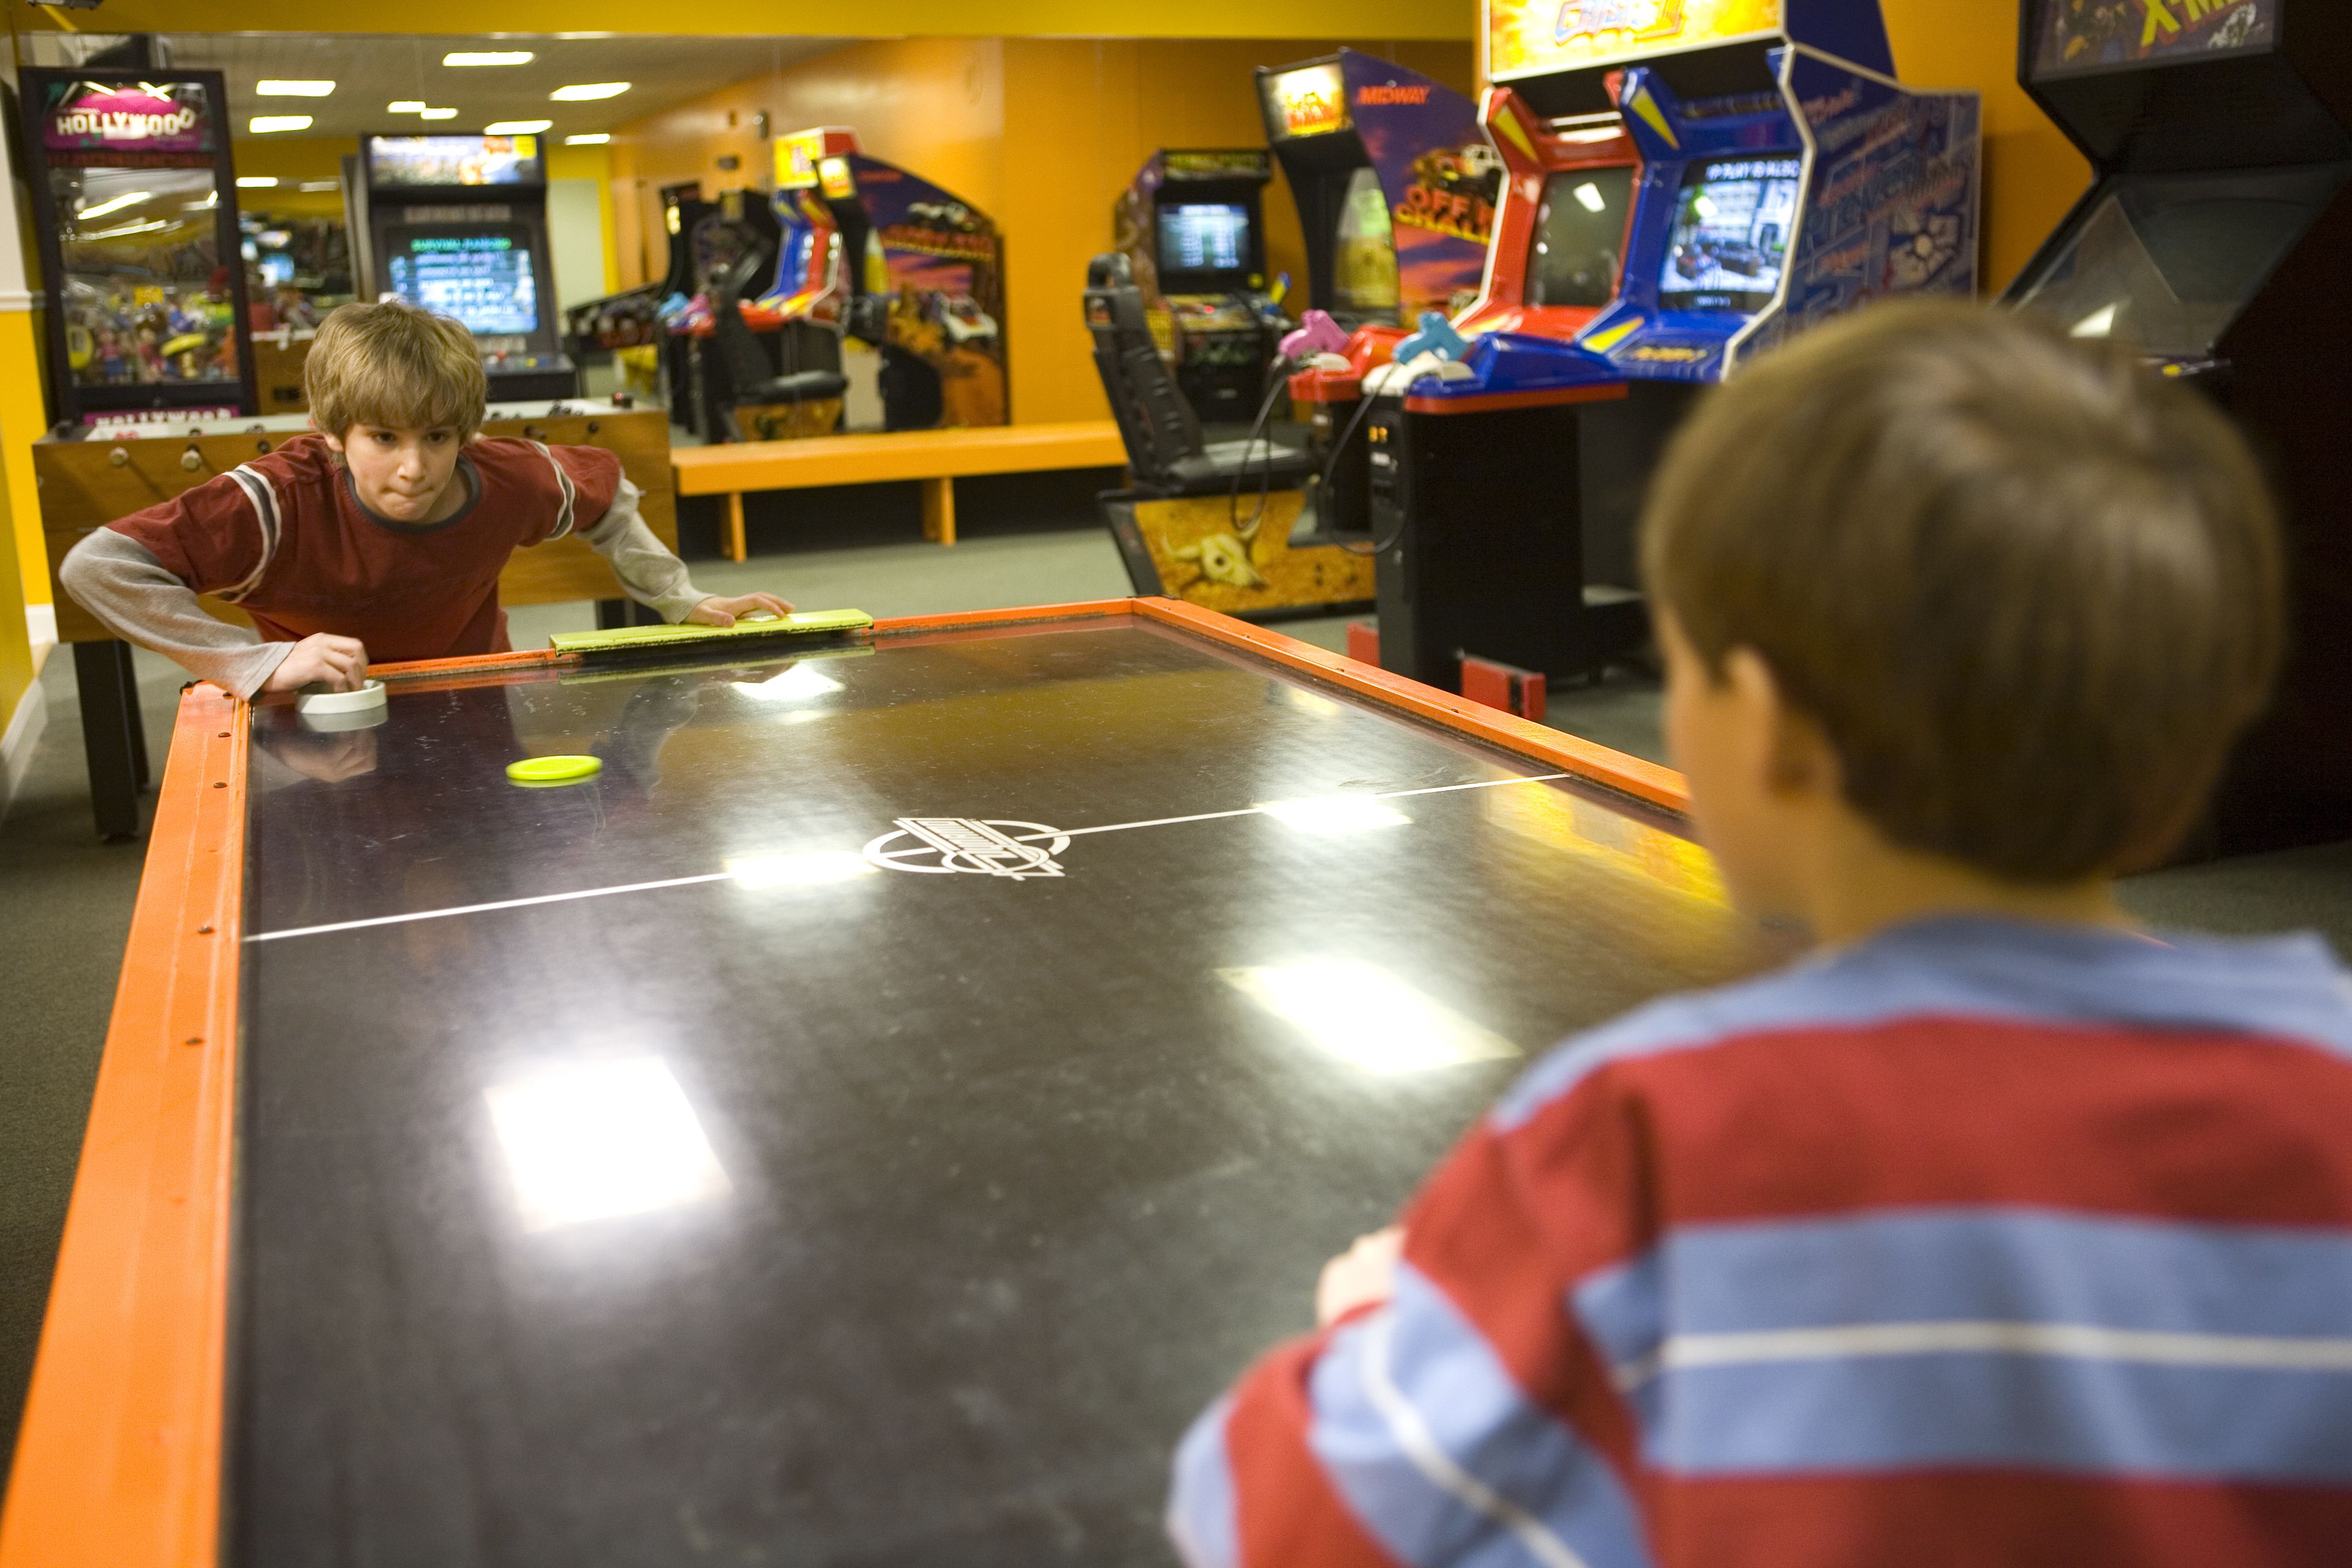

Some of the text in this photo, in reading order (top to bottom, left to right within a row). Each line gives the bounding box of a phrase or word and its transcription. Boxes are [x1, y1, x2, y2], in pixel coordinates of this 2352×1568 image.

[1358, 86, 1430, 104] MIDWAY
[56, 107, 195, 136] HOLLYWOOD
[1722, 162, 1751, 180] PLAY
[1405, 184, 1470, 219] OFF
